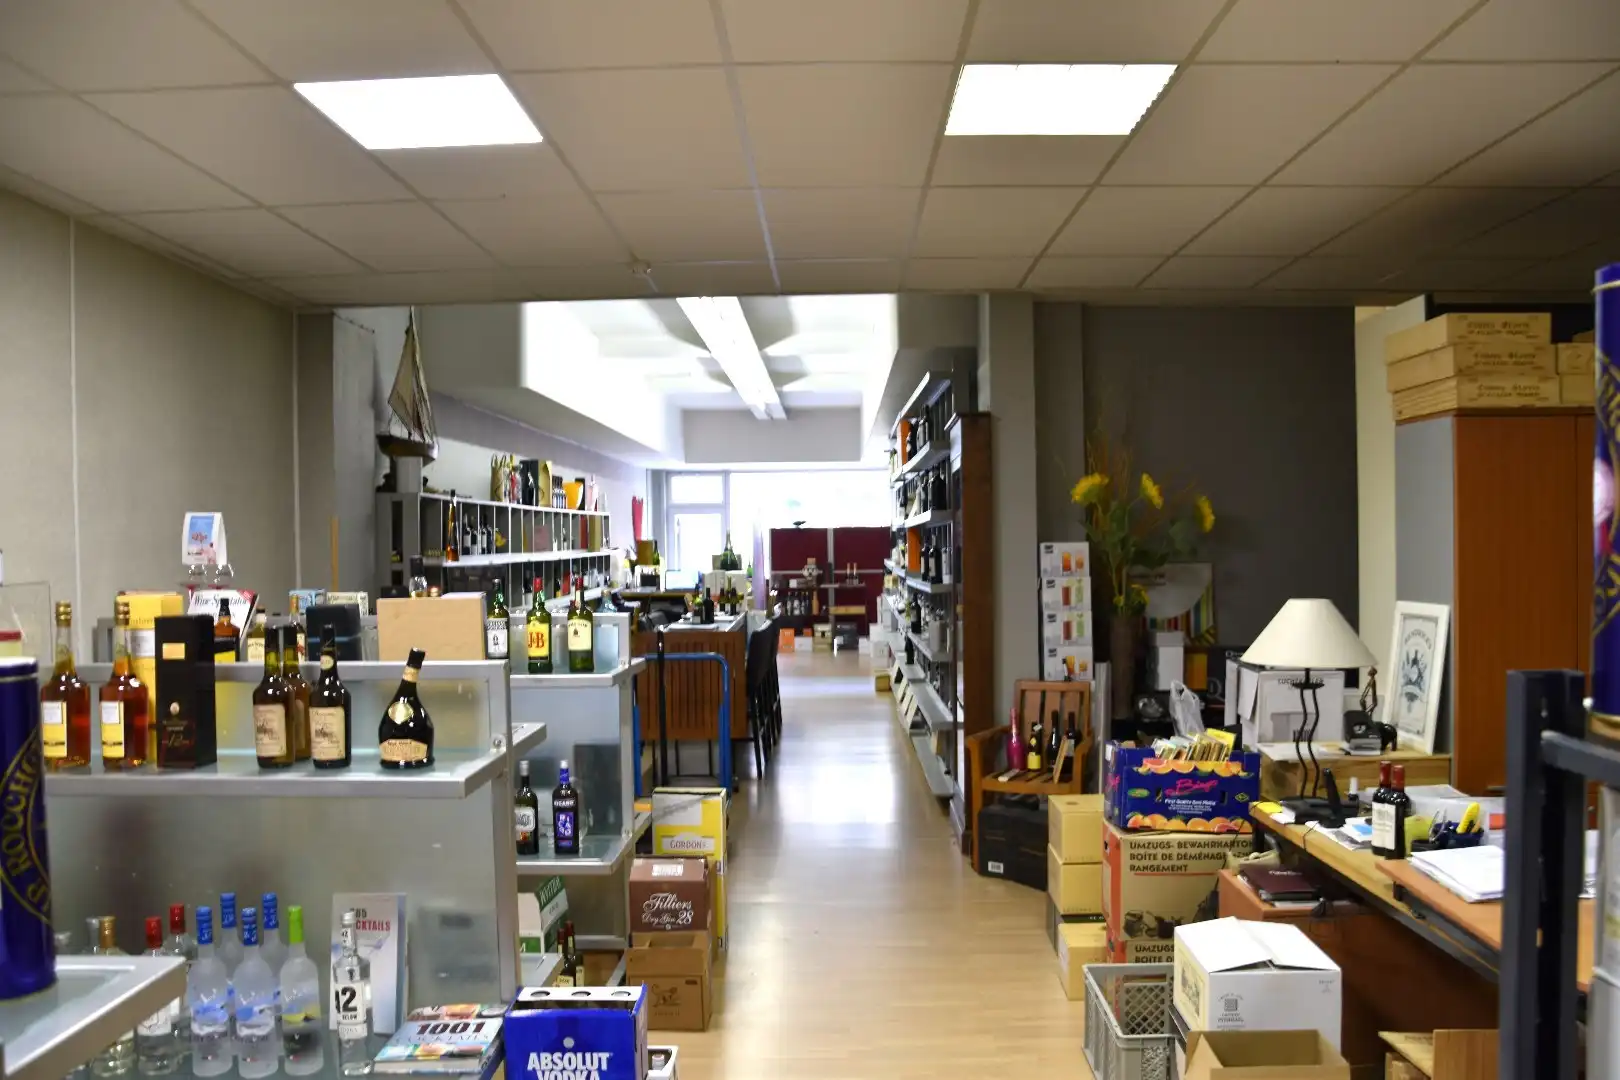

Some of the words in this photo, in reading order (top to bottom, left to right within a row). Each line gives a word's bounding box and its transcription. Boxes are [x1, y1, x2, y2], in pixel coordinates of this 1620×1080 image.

[213, 593, 248, 609] Sptator
[528, 631, 545, 649] J&B
[1161, 853, 1173, 861] DE
[1129, 863, 1189, 873] RANGEMENT
[675, 909, 694, 925] 28
[416, 1021, 486, 1035] 1001
[526, 1052, 610, 1071] ABSOLUT
